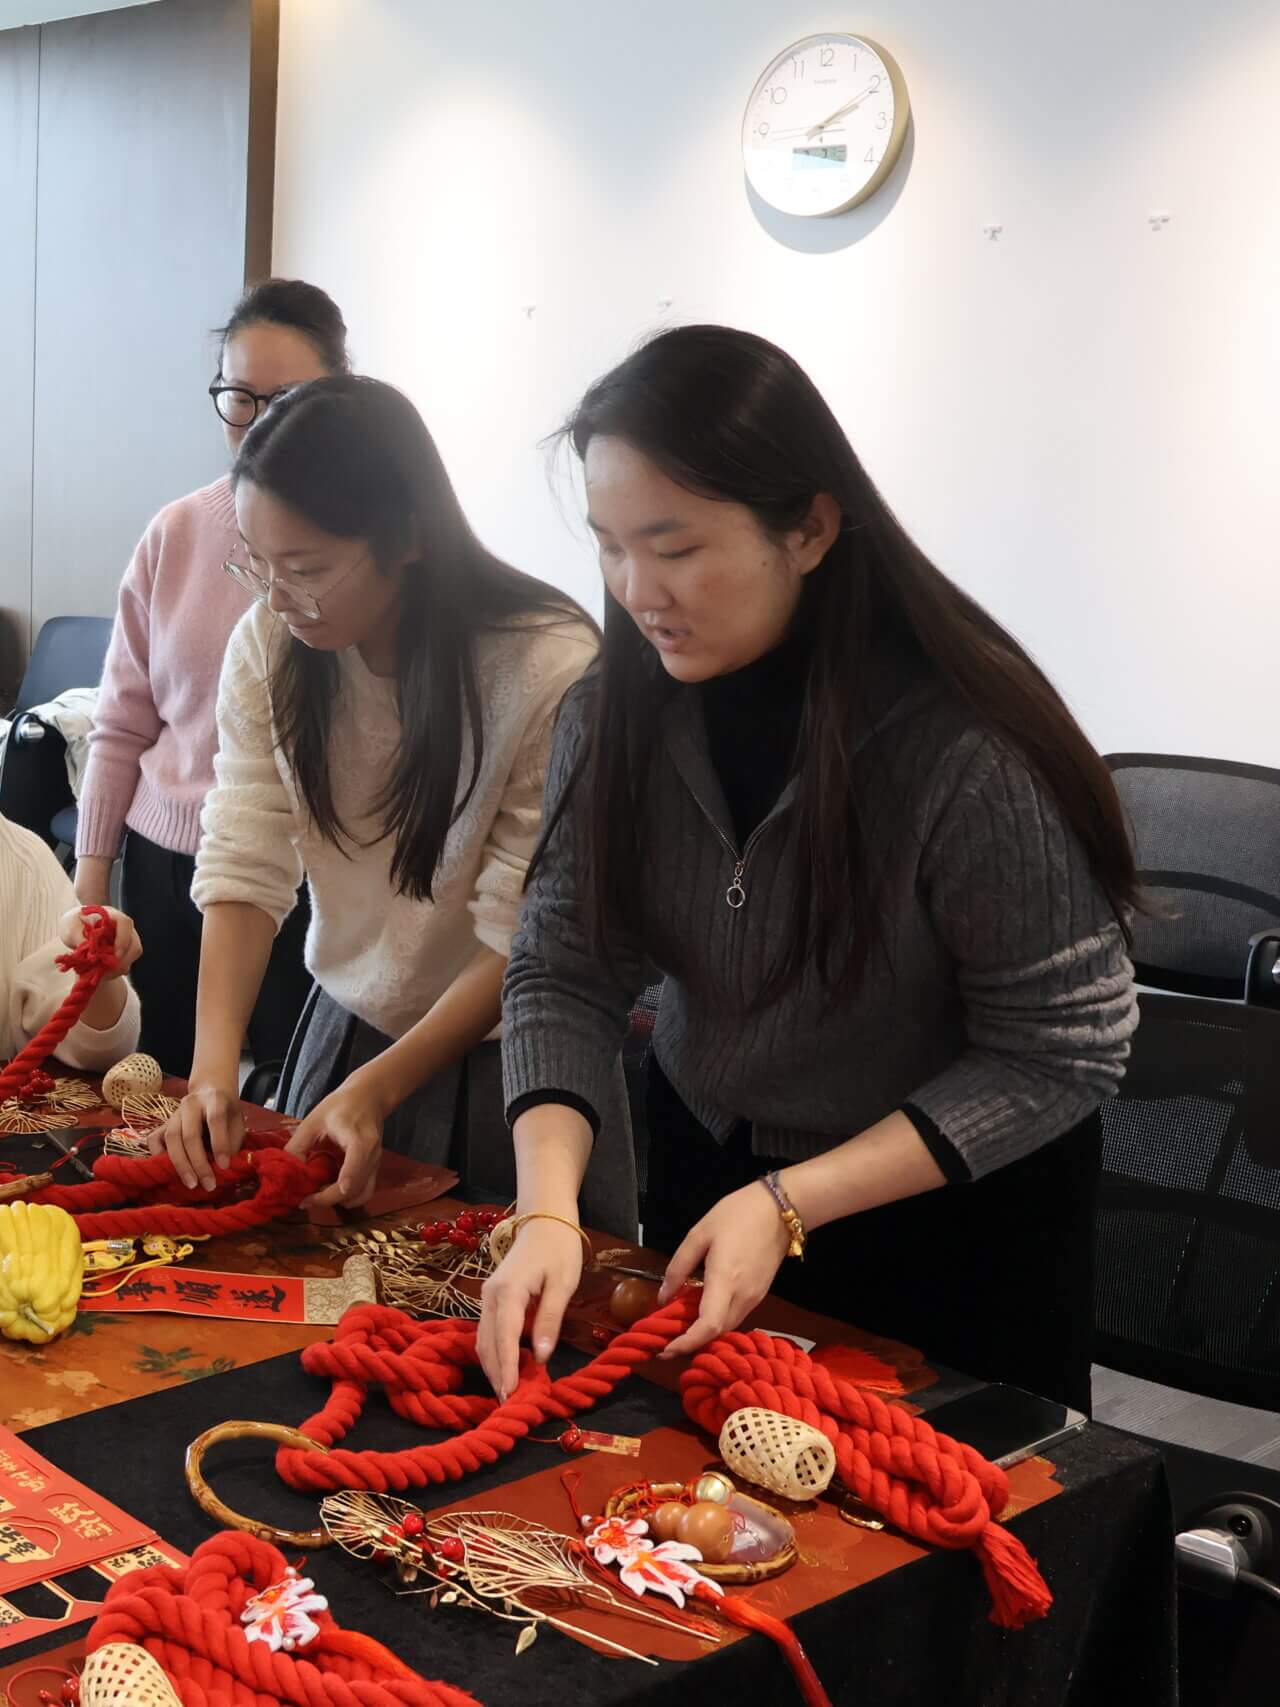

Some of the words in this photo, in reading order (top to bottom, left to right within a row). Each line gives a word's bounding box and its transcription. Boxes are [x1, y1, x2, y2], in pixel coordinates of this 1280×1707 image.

[819, 47, 835, 67] 12
[869, 74, 882, 94] 2
[769, 86, 788, 105] 10
[875, 112, 888, 130] 3
[863, 145, 875, 163] 4
